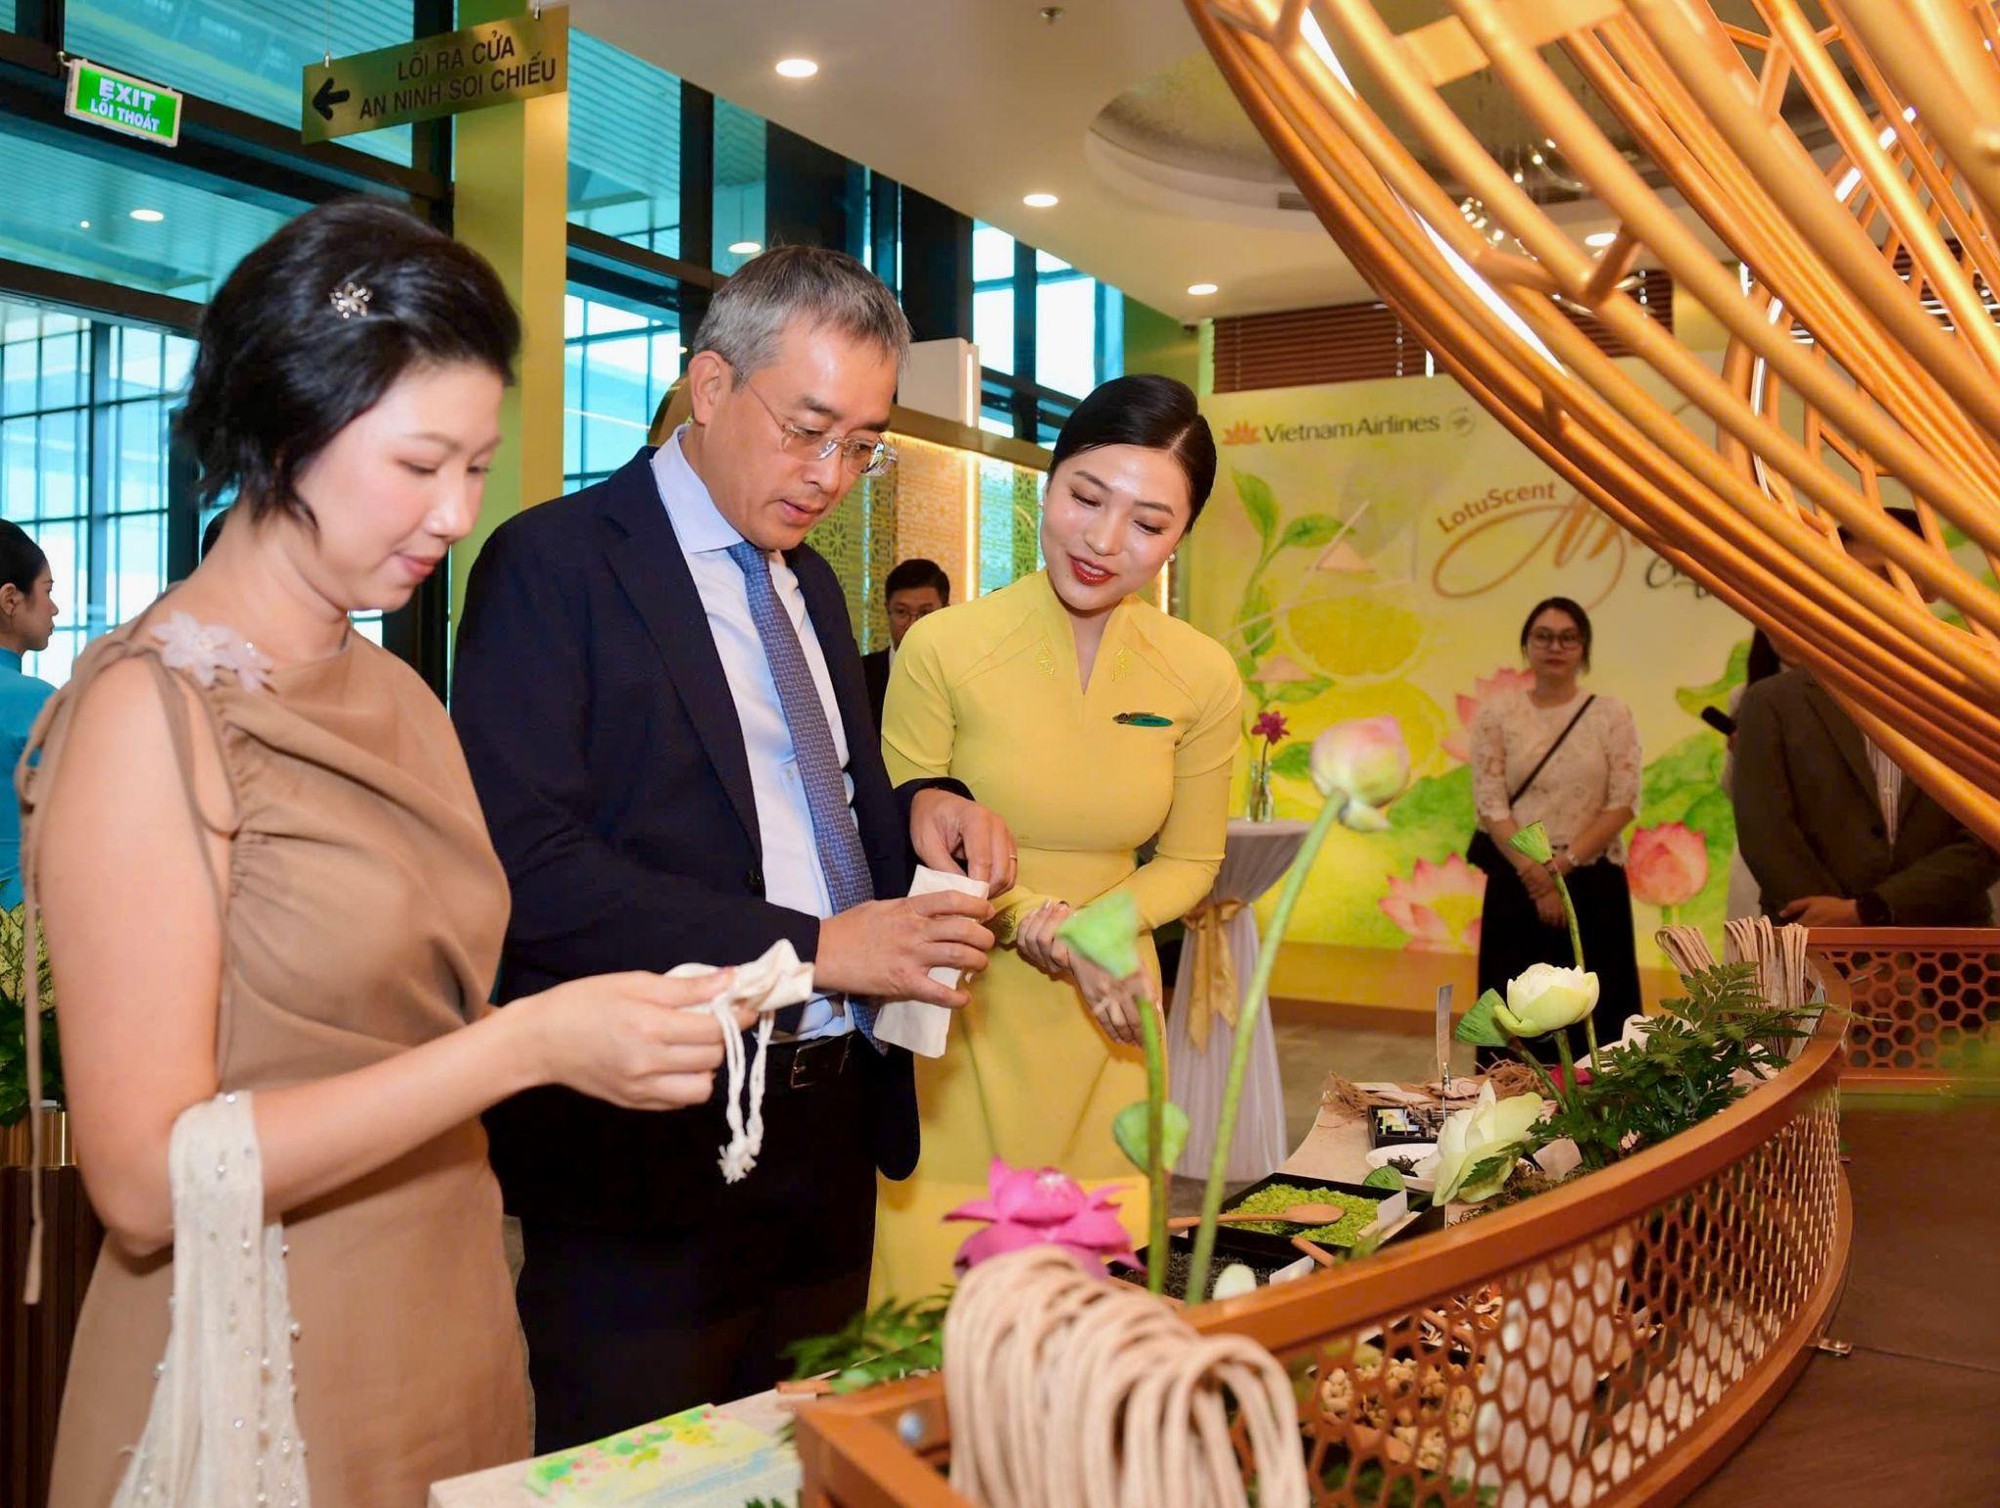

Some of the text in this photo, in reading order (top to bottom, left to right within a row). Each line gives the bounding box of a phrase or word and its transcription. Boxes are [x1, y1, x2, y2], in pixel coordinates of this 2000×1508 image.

[437, 47, 465, 71] RA
[472, 30, 515, 64] CỬA
[98, 77, 157, 112] EXIT
[360, 51, 556, 119] AN NINH SOI CHIẾU
[116, 107, 160, 132] THOÁT
[1264, 413, 1441, 443] Vietnam Airlines
[1436, 480, 1558, 533] LotuScent
